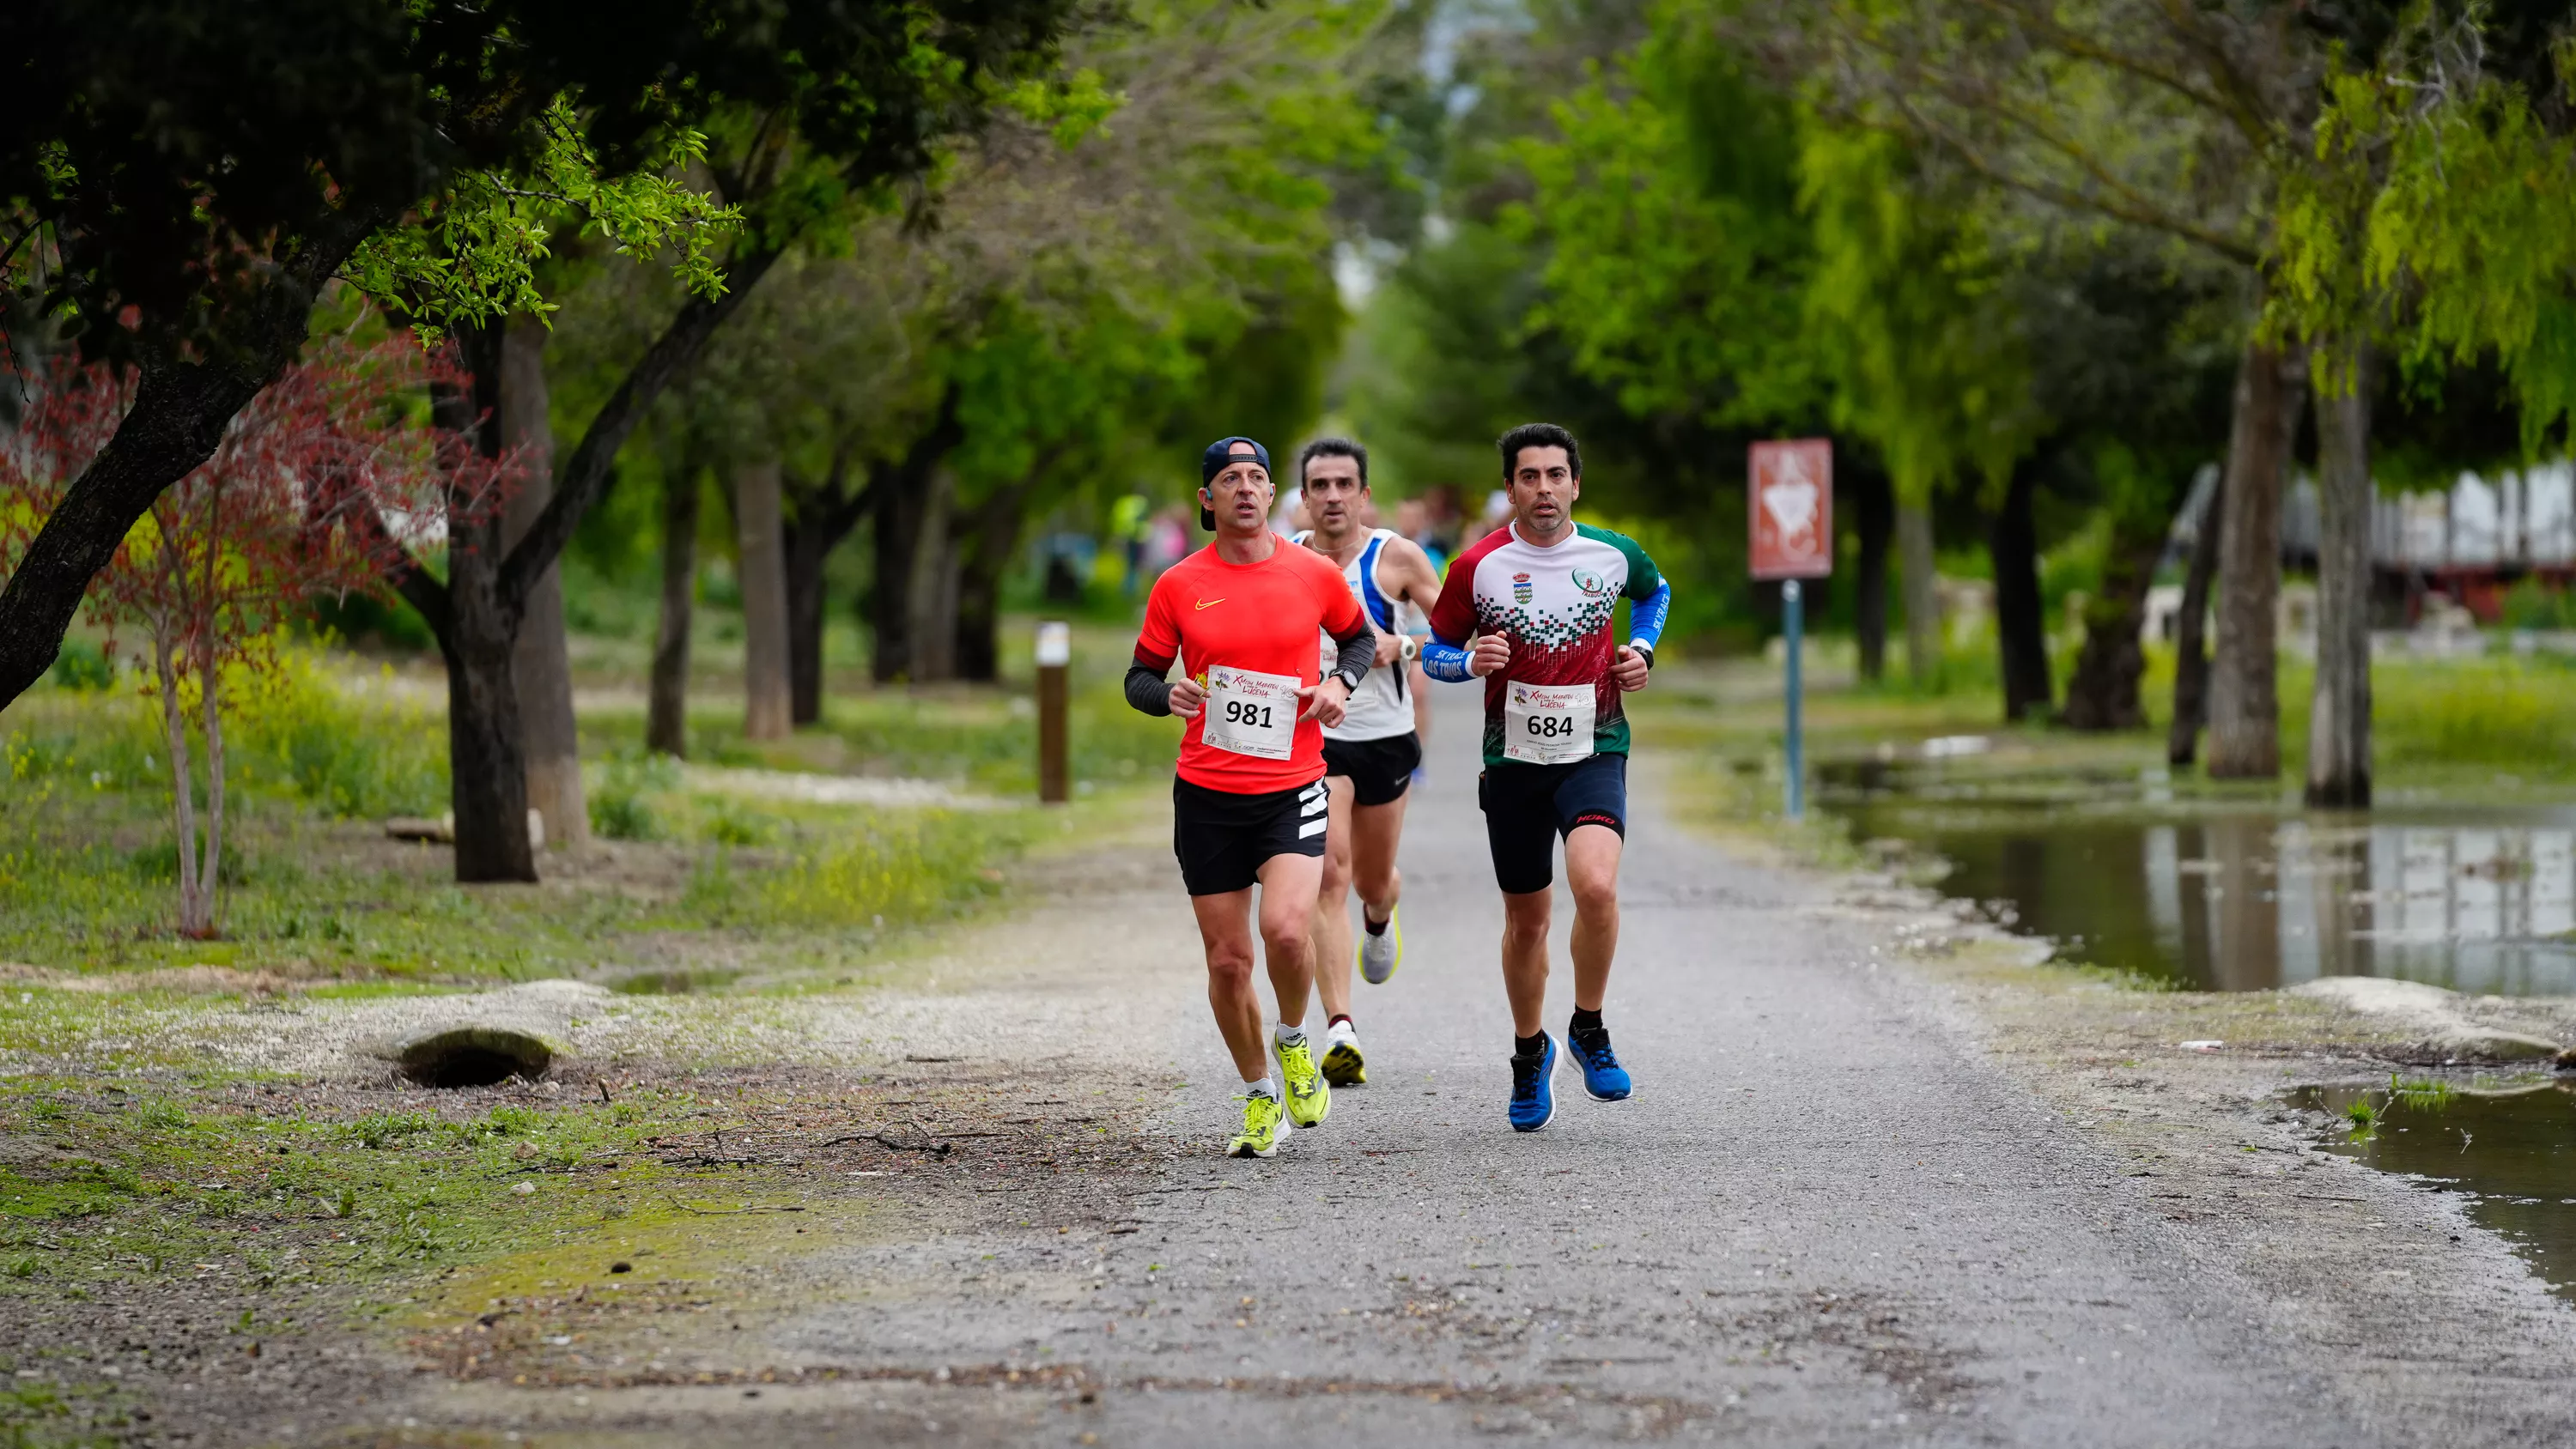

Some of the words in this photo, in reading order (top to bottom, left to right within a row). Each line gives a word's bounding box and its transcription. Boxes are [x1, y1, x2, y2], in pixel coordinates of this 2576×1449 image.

[1653, 594, 1670, 633] SKYRACE
[1435, 650, 1466, 661] SKYRACE
[1425, 658, 1438, 675] LOS
[1242, 686, 1271, 698] LUCENA
[1540, 700, 1567, 709] LUCENA
[1226, 700, 1273, 729] 981
[1528, 715, 1573, 737] 684
[1577, 815, 1615, 824] HOKO
